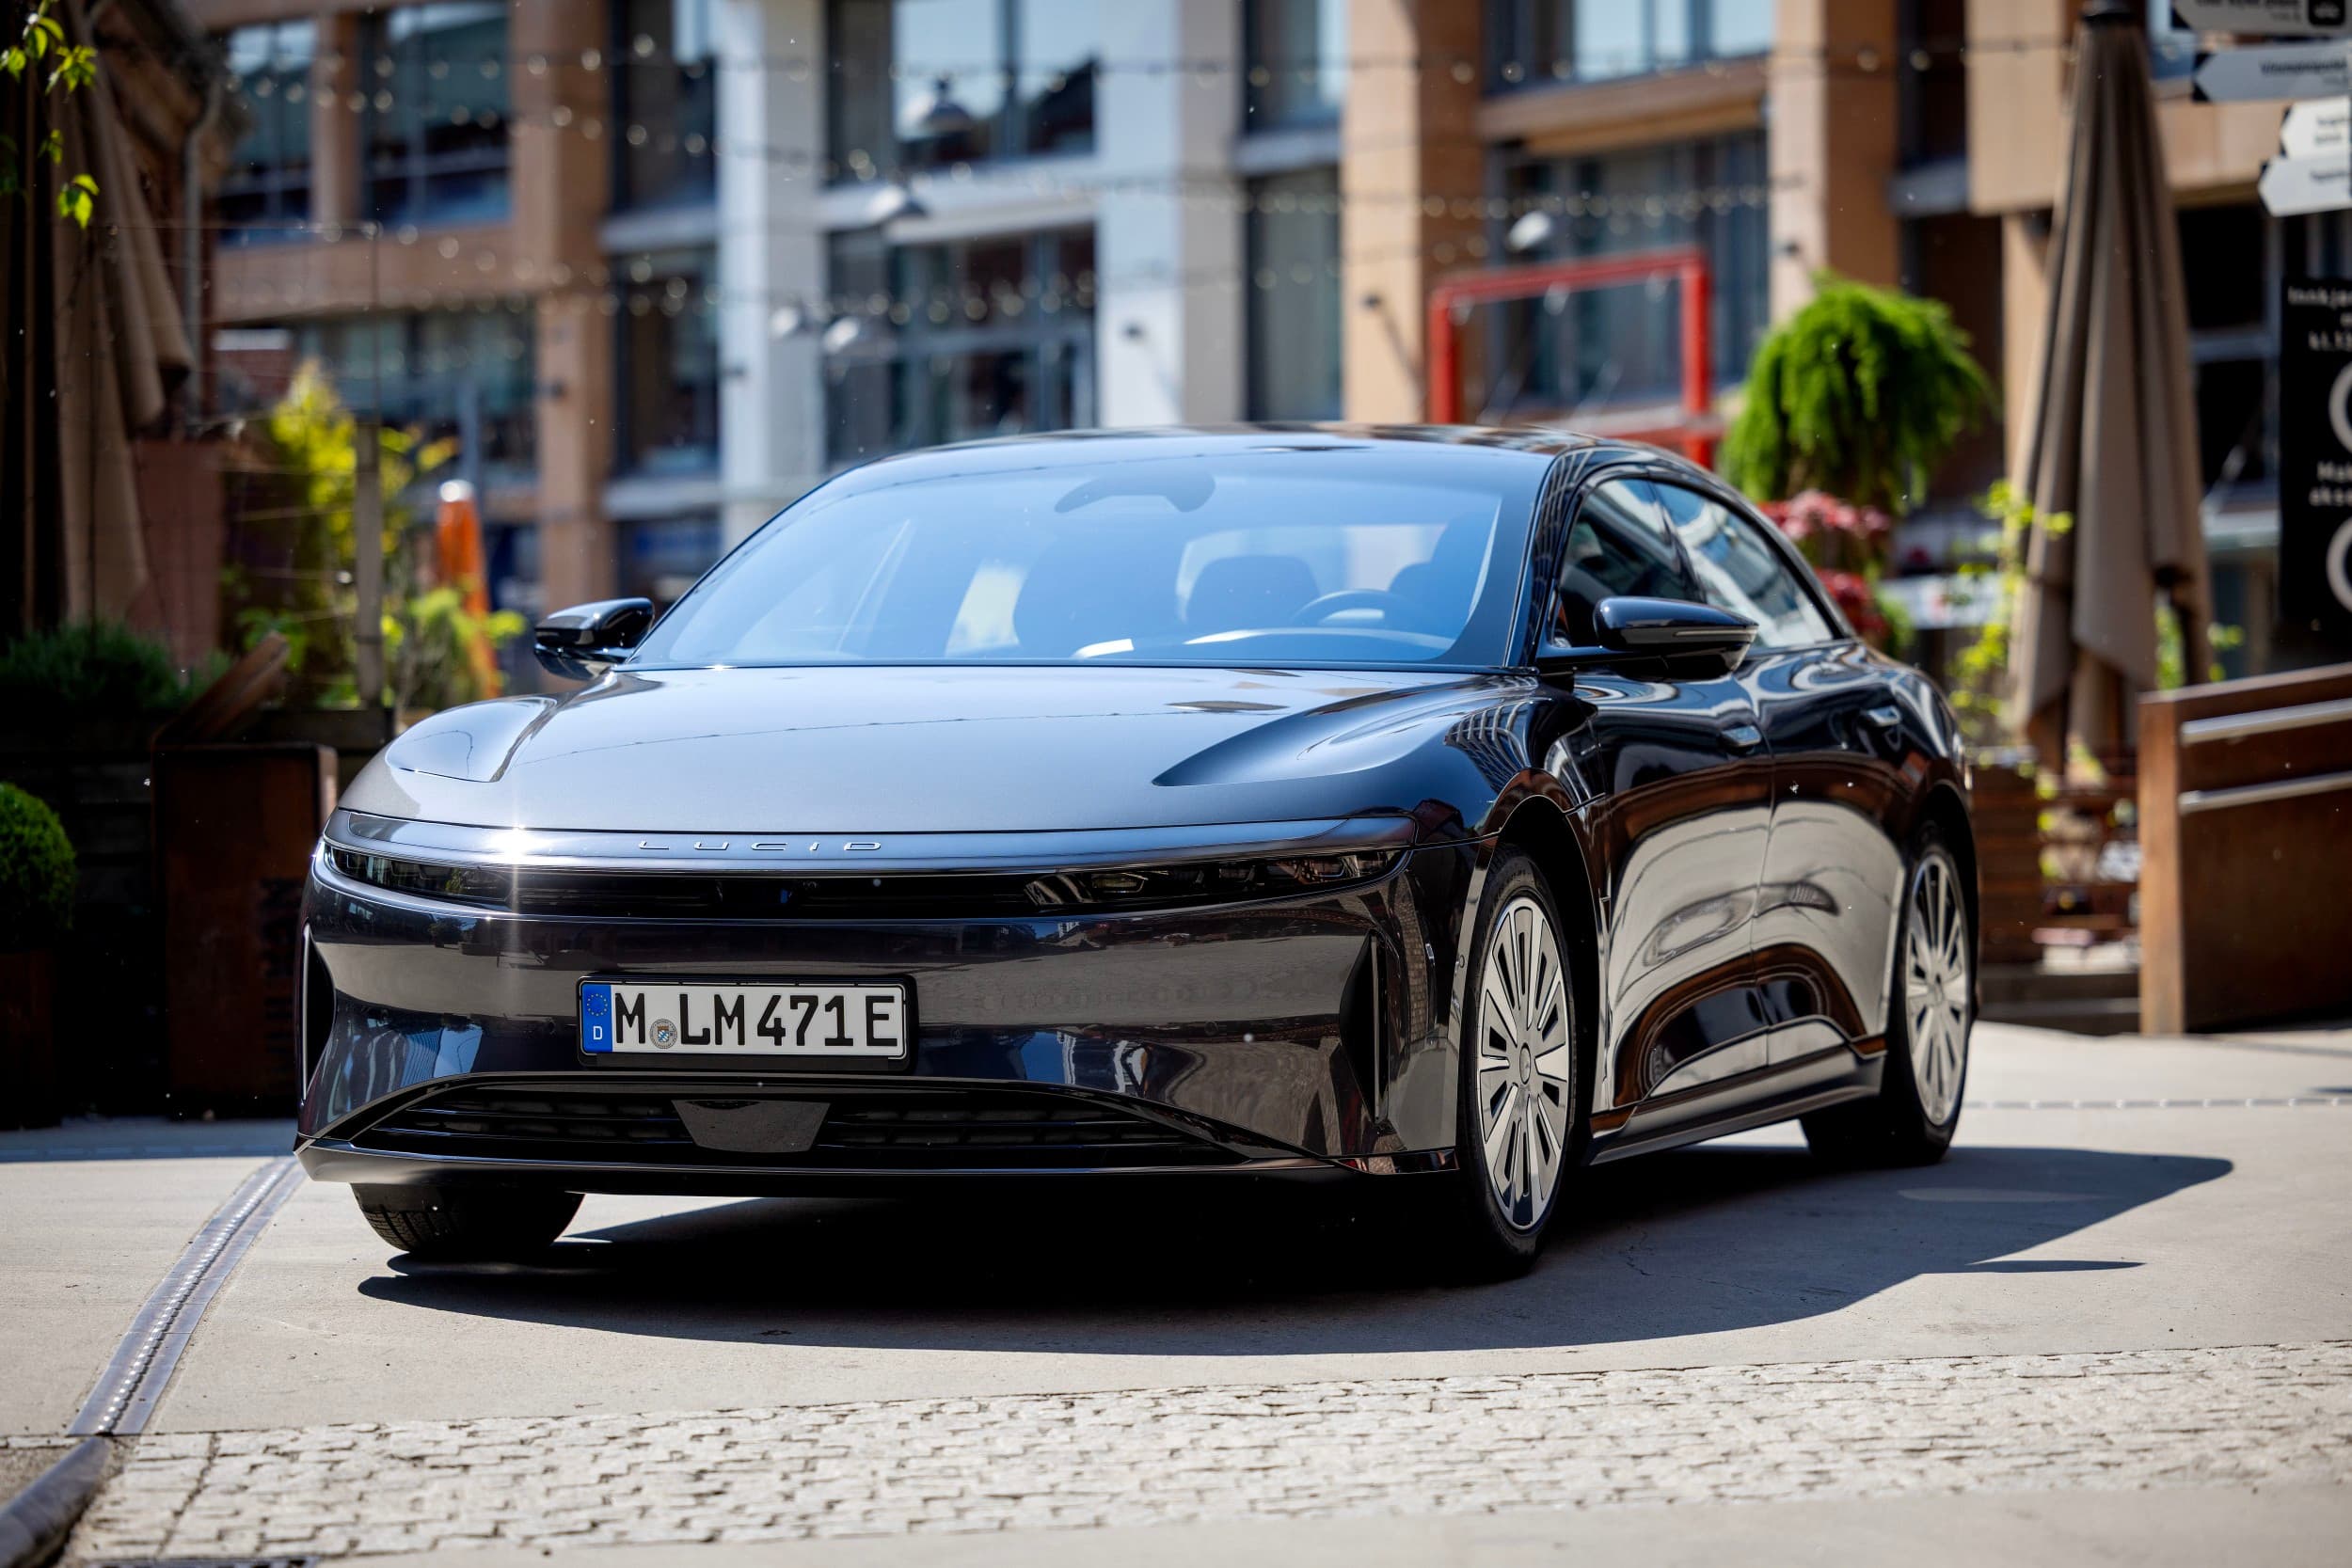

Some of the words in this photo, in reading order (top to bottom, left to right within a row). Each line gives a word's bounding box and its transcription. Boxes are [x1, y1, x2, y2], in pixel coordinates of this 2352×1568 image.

[638, 841, 882, 851] LUCID
[614, 992, 646, 1045] M
[593, 1025, 603, 1040] D
